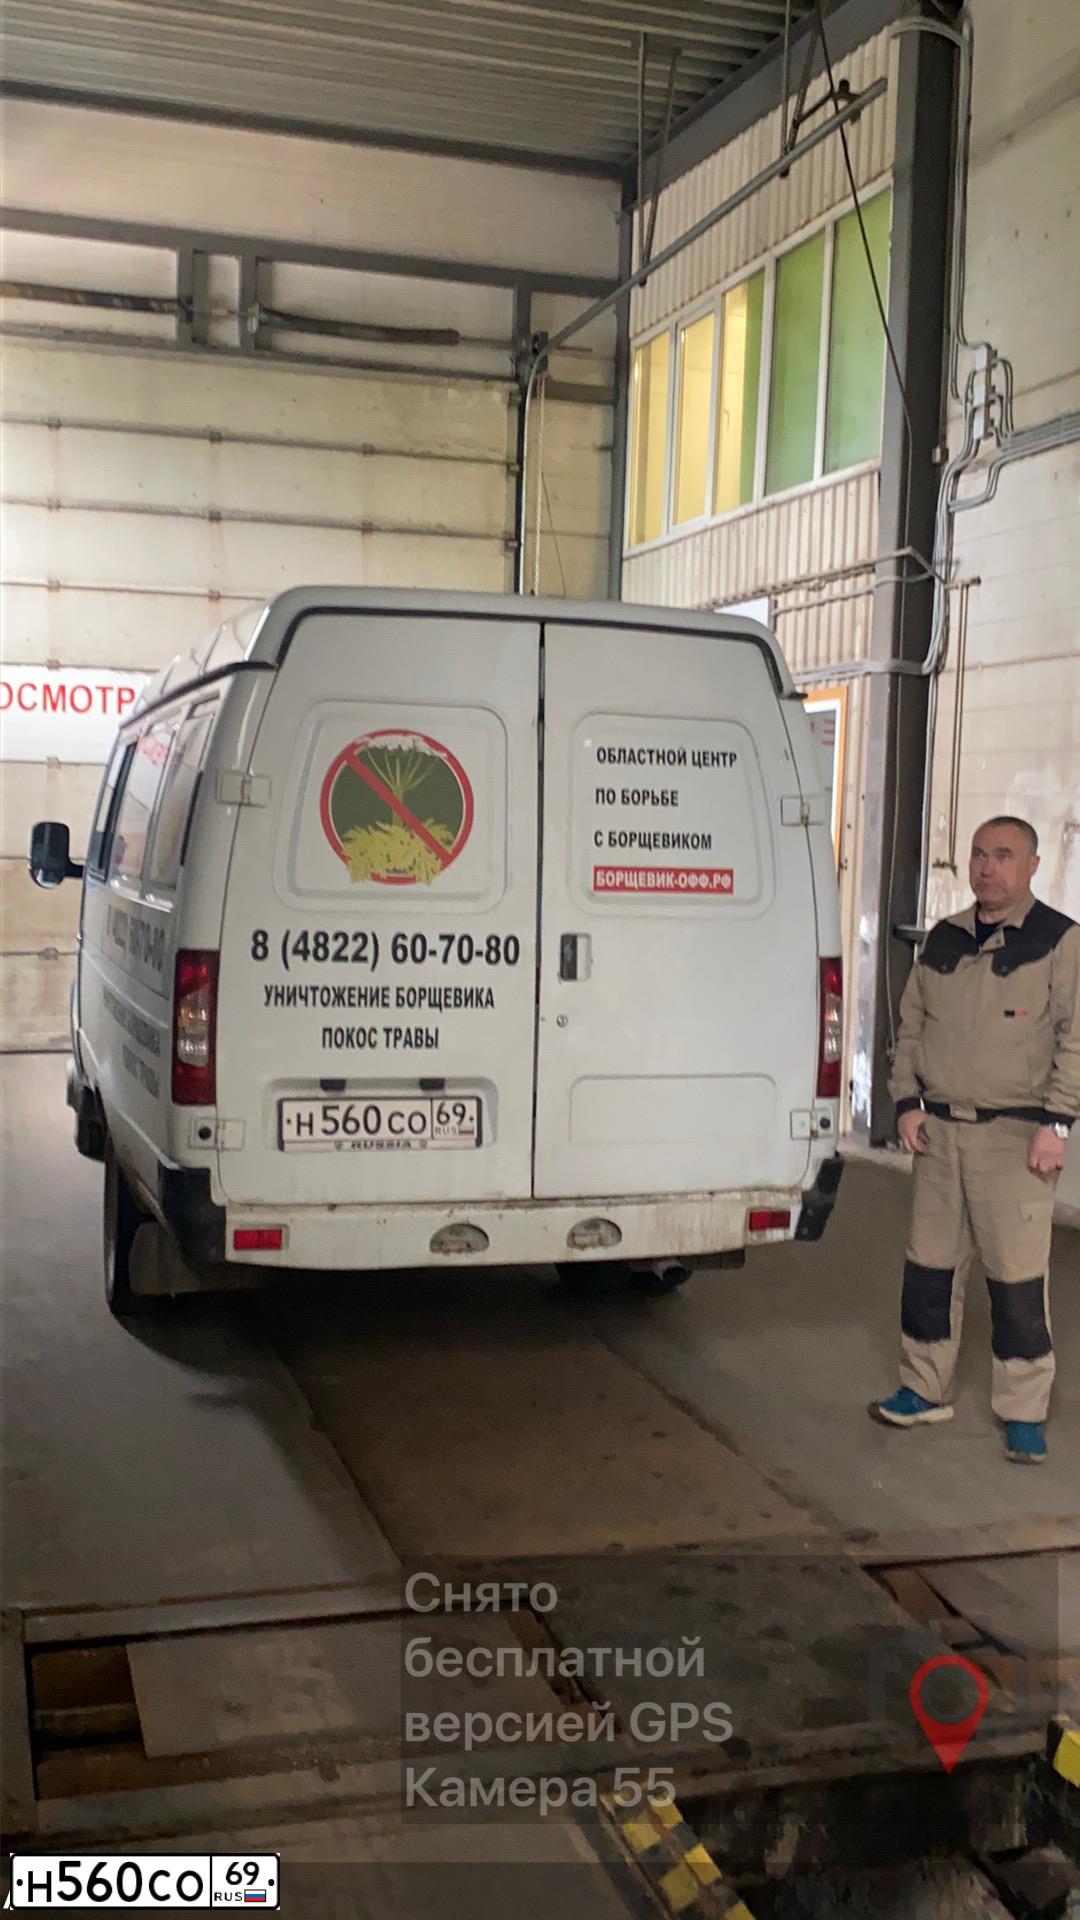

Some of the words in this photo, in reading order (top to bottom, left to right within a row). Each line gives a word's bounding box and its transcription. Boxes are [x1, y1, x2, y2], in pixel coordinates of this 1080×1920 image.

[596, 746, 687, 766] ОБЛАСТНОЙ
[691, 751, 738, 769] ЦЕНТР
[595, 788, 616, 805] ПО
[621, 789, 679, 807] БОРЬБЕ
[594, 831, 603, 848] С
[608, 831, 712, 851] БОРЩЕВИКОМ
[251, 930, 269, 960] 8
[281, 930, 379, 971] (4822)
[391, 934, 520, 965] 60-70-80
[264, 984, 390, 1007] УНИЧТОЖЕНИЕ
[396, 987, 495, 1012] БОРЩЕВИКА
[322, 1027, 378, 1049] ПОКОС
[383, 1028, 439, 1049] ТРАВЫ
[435, 1102, 467, 1126] 69
[434, 1127, 457, 1136] RUS
